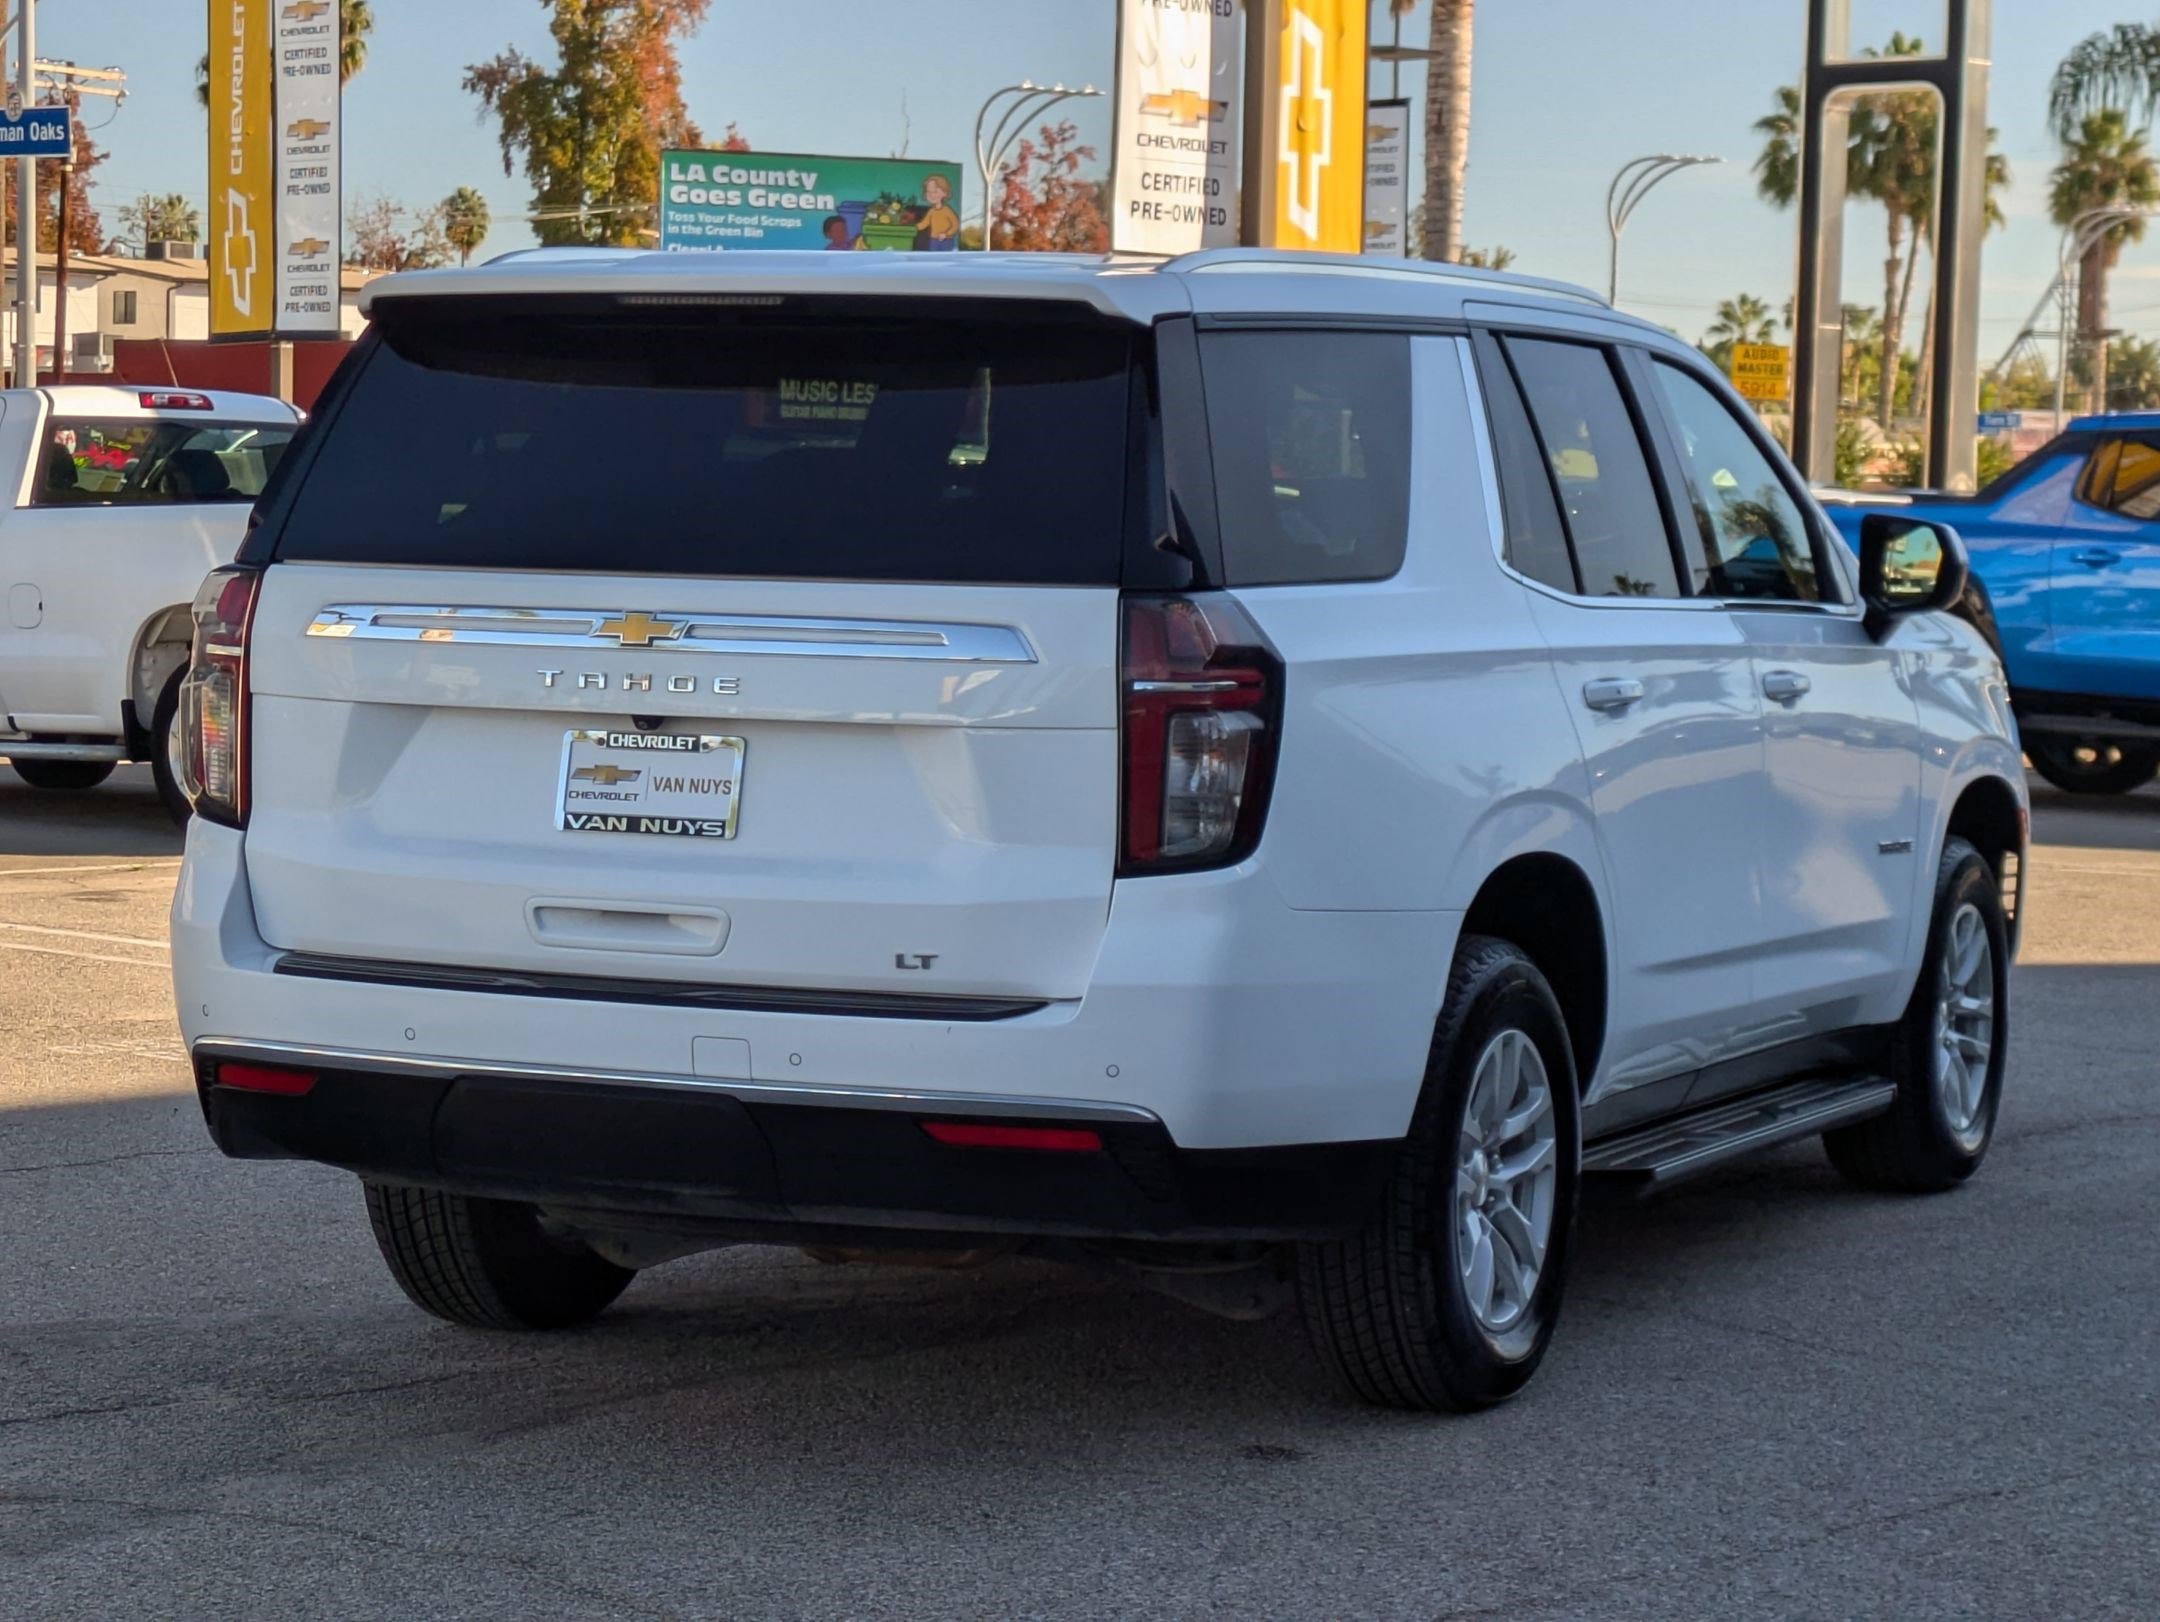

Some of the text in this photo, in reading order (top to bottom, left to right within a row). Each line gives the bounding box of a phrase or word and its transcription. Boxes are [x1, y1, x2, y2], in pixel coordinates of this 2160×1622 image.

[281, 25, 330, 37] CHEVROLET
[284, 47, 328, 61] CERTIFIED
[283, 63, 332, 77] PRE-OWNED
[230, 0, 245, 175] CHEVROLET
[30, 121, 65, 141] Oaks
[1136, 133, 1228, 155] CHEVROLET
[670, 163, 818, 191] LA County
[1141, 172, 1220, 196] CERTIFIED
[287, 183, 331, 196] PRE-OWNED
[670, 185, 835, 210] Goes Green
[668, 211, 802, 228] Toss Your Food Scraps
[1130, 200, 1227, 226] PRE-OWNED
[668, 224, 764, 238] in the Green Bin
[287, 263, 331, 273] CHEVROLET
[290, 285, 328, 297] CERTIFIED
[285, 301, 332, 314] PRE-OWNED
[1743, 348, 1780, 361] AUDIO
[1737, 362, 1784, 375] MASTER
[780, 378, 838, 402] MUSIC
[1740, 381, 1777, 397] 5914
[536, 669, 743, 695] TAHOE
[609, 734, 696, 750] CHEVROLET
[653, 776, 732, 796] VAN NUYS
[568, 790, 640, 803] CHEVROLET
[566, 814, 724, 837] VAN NUYS
[895, 953, 939, 970] LT
